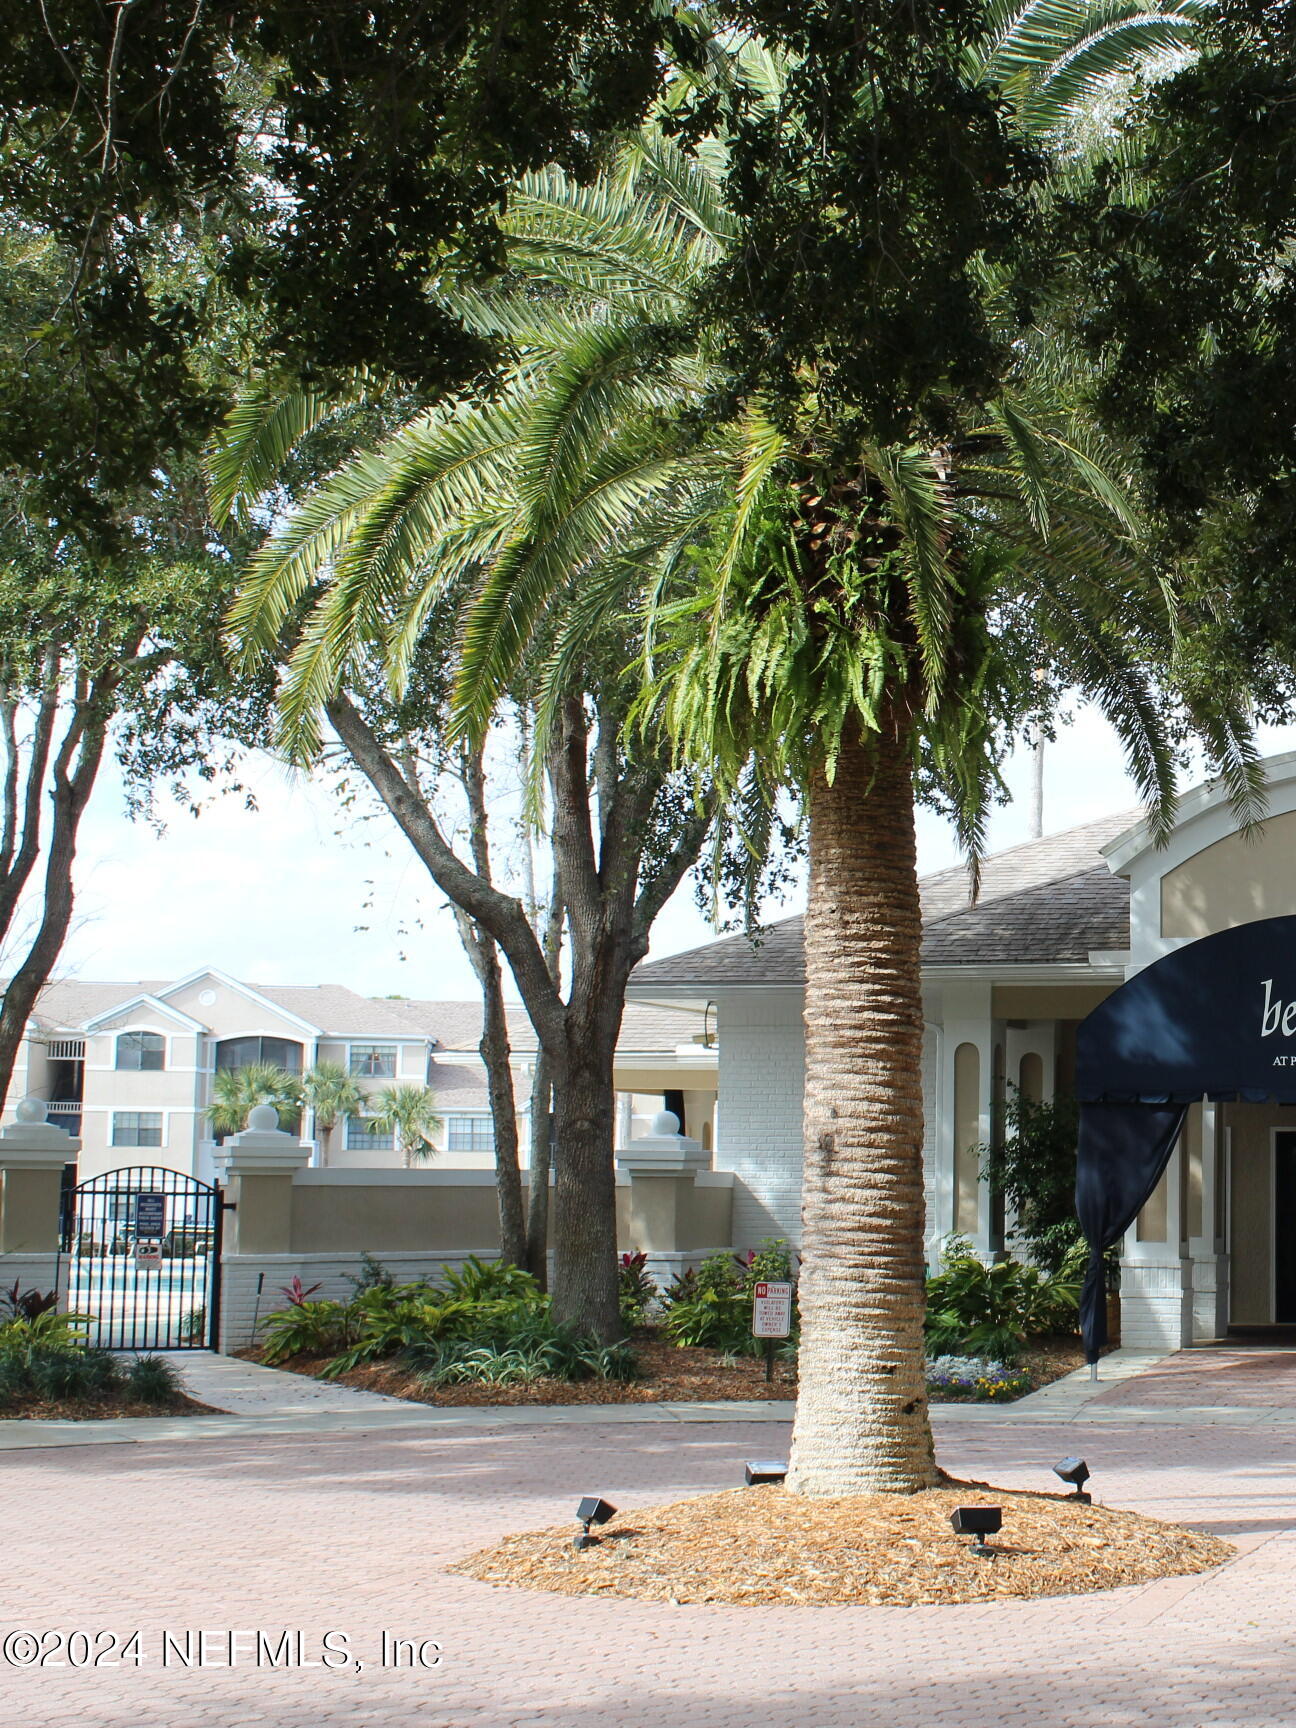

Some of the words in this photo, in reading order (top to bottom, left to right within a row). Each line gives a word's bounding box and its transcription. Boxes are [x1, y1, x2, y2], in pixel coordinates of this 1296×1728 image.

[1272, 1056, 1288, 1066] AT
[757, 1286, 766, 1295] NO
[768, 1287, 788, 1295] PARKING
